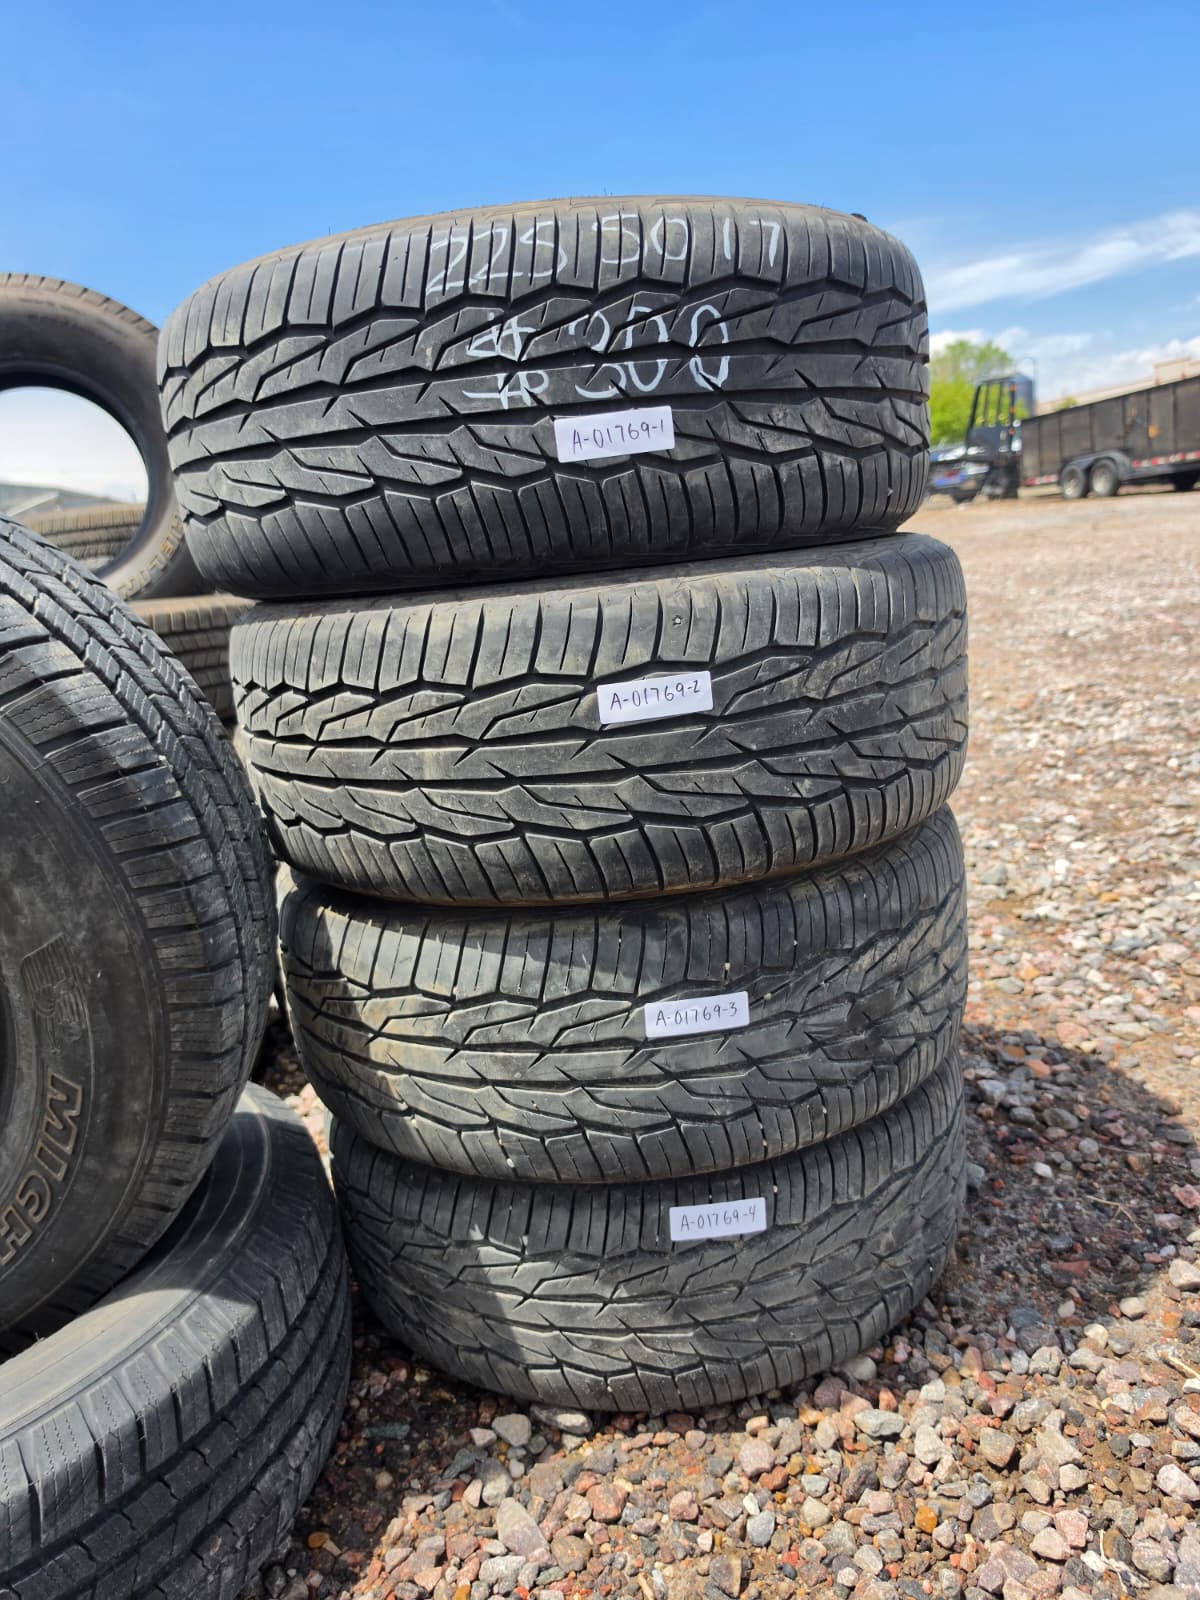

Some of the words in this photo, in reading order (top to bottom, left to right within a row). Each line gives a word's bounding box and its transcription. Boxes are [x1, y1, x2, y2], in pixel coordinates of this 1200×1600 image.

[426, 220, 568, 297] 225
[592, 214, 695, 264] 50
[722, 217, 781, 267] 17
[572, 419, 664, 455] A-01769-1
[610, 679, 701, 711] A-01769-2
[655, 1001, 738, 1027] A-01769-3
[680, 1204, 757, 1232] A-01769-4
